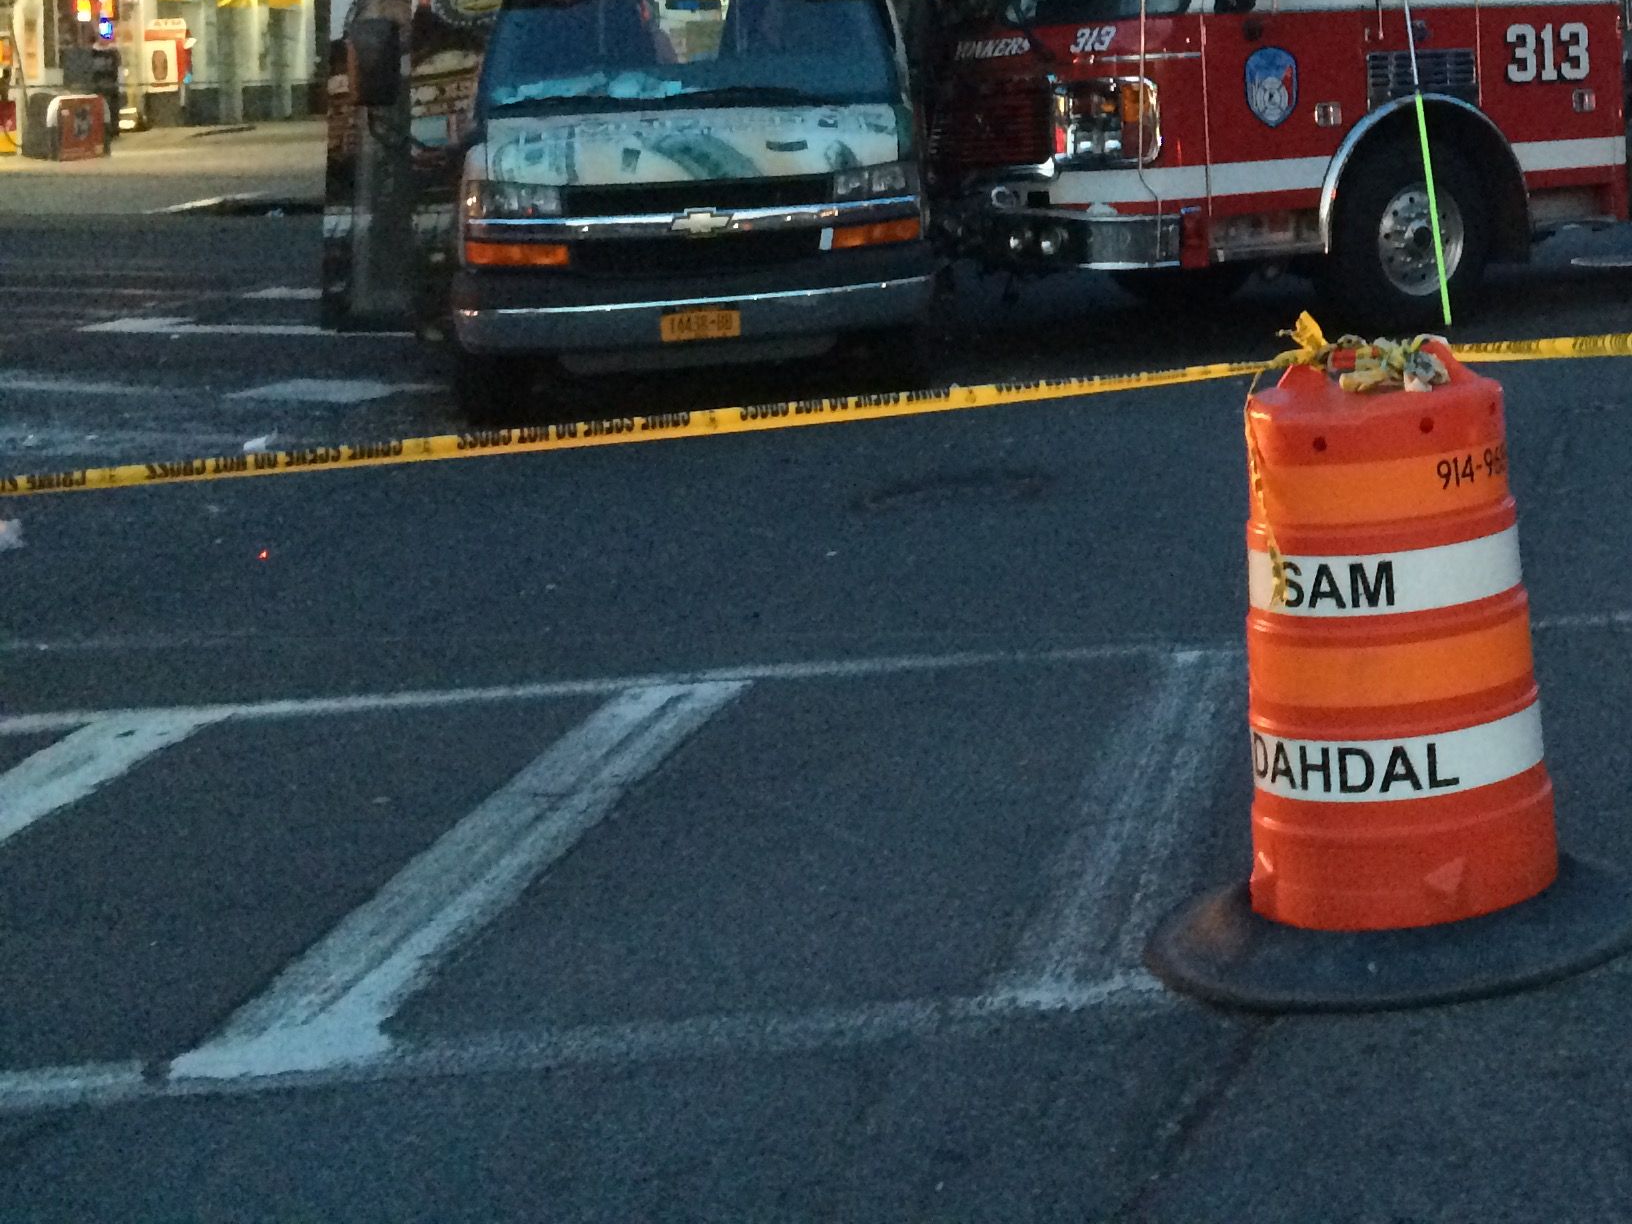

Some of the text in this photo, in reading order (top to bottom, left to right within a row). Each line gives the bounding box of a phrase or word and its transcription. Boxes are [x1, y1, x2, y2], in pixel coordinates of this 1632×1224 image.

[1070, 26, 1117, 54] 313
[1506, 22, 1590, 82] 313
[1283, 560, 1395, 609] SAM
[1253, 732, 1460, 793] DAHDAL
